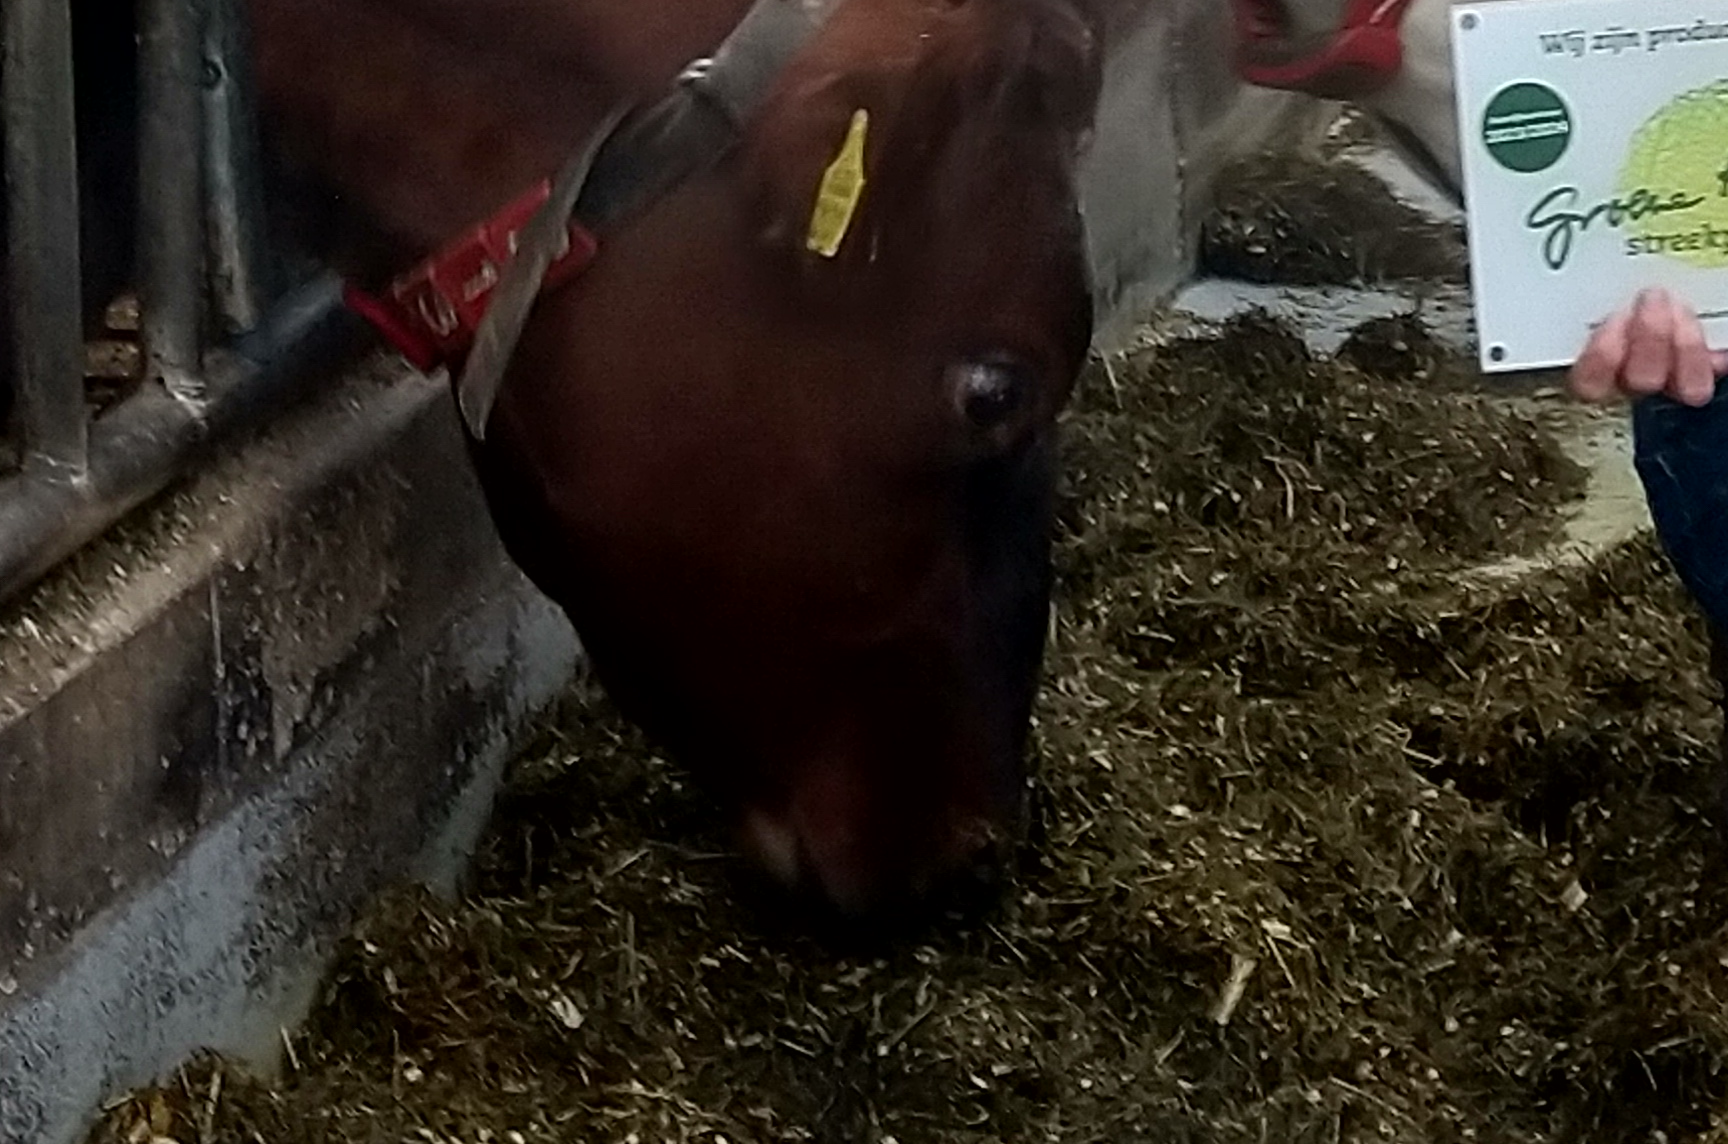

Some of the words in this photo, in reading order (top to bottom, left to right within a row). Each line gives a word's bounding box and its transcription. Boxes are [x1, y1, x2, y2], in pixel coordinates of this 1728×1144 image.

[1539, 29, 1585, 58] Wij
[1590, 25, 1640, 55] zijn
[1526, 186, 1706, 271] Groene
